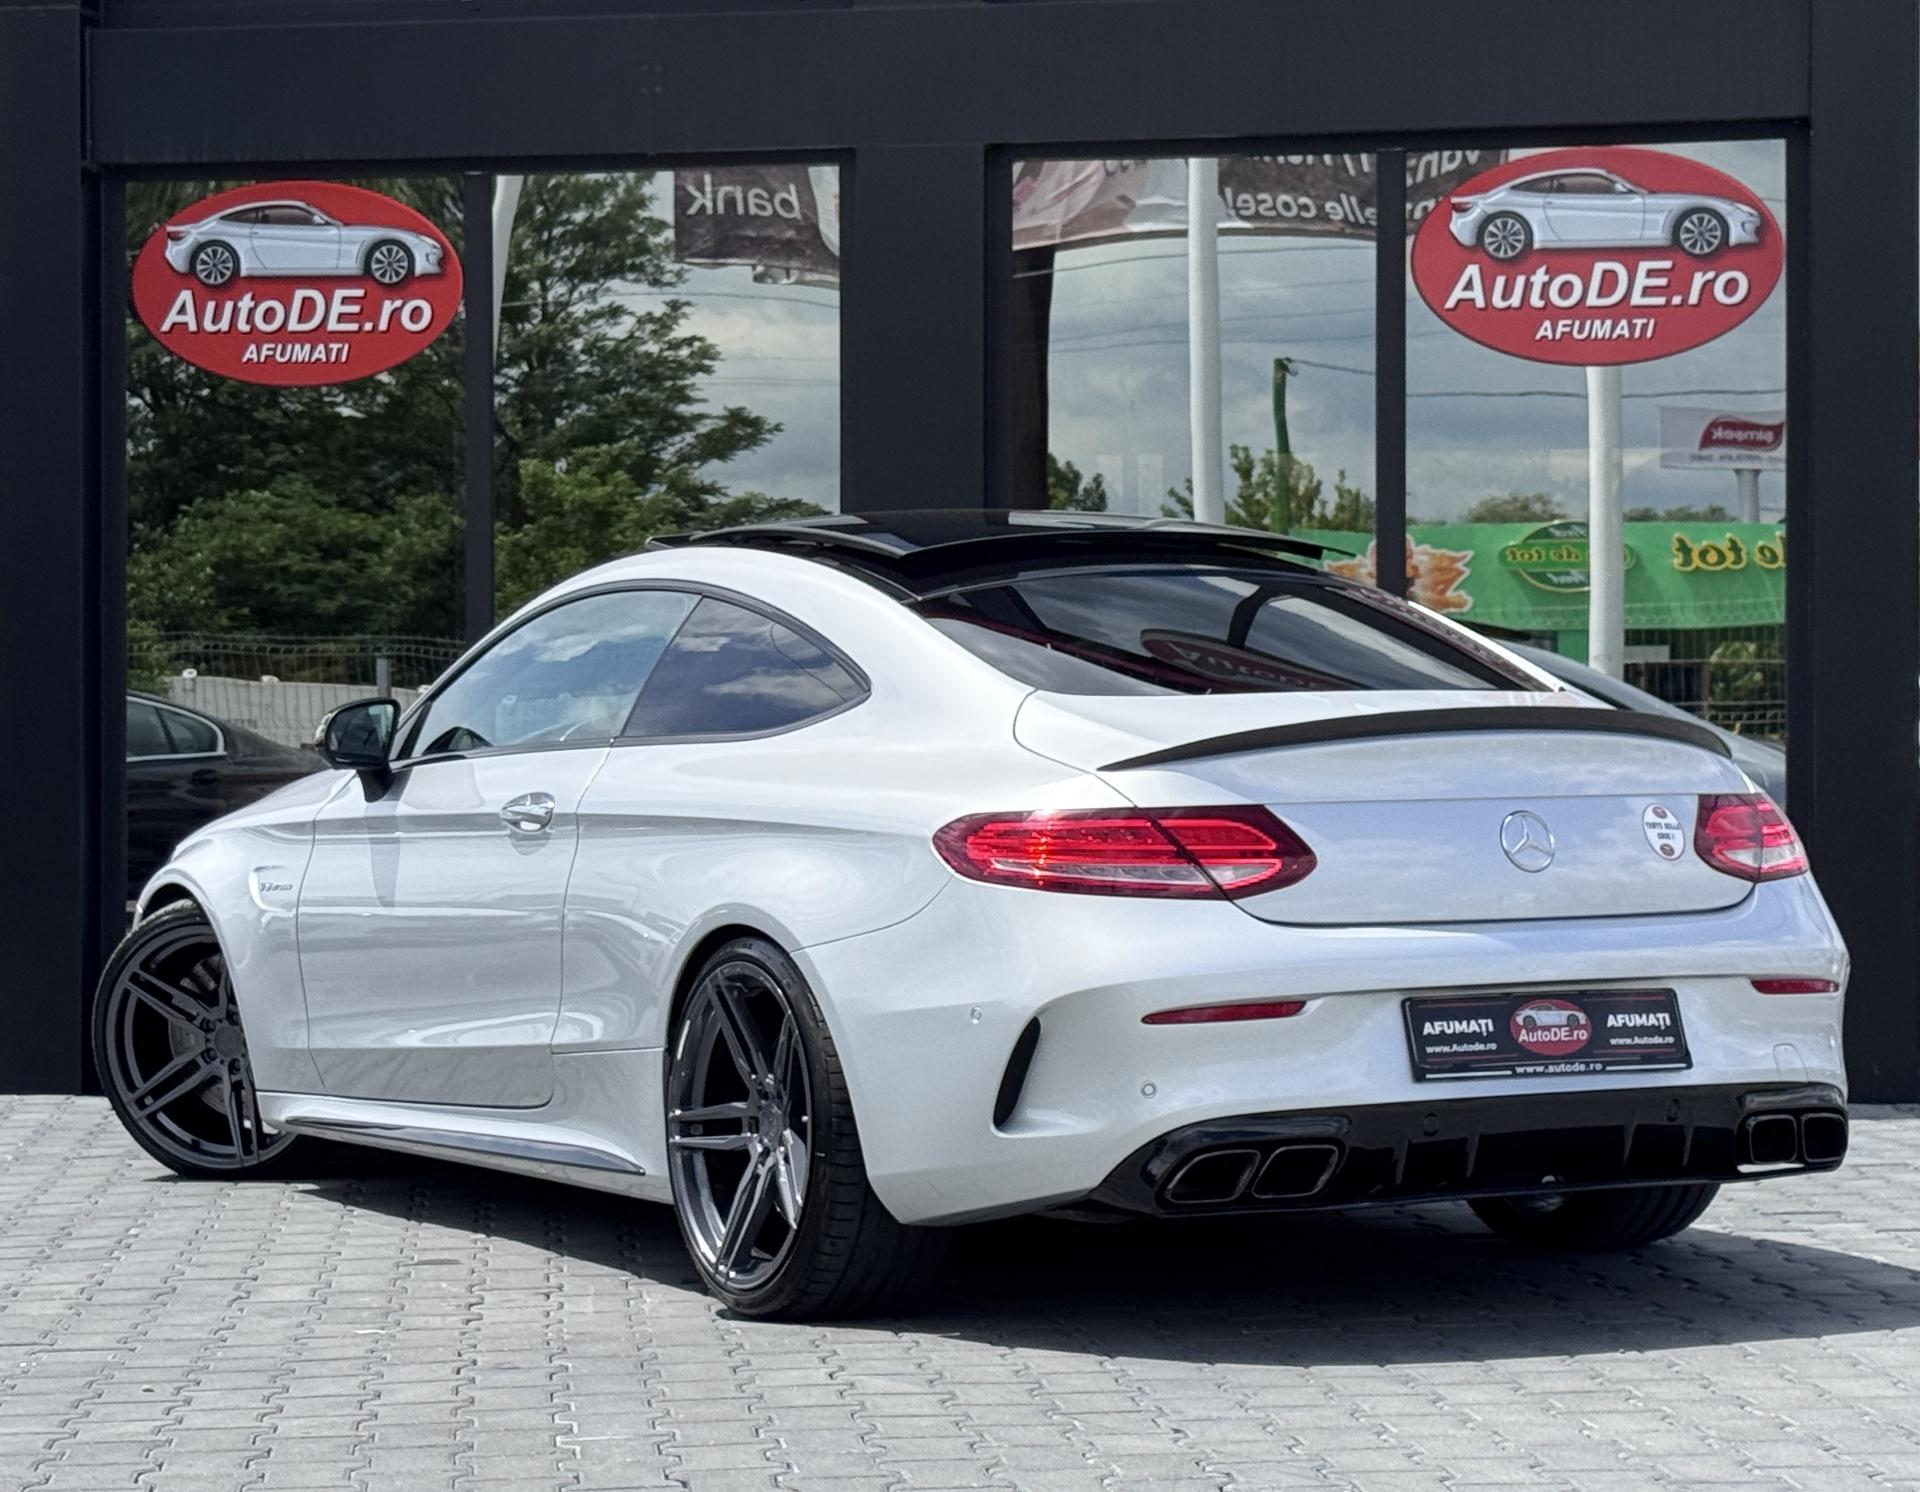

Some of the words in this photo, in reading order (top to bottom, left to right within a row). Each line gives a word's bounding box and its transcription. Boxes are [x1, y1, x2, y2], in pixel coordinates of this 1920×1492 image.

[1444, 260, 1750, 309] AutoDE.ro
[160, 289, 433, 334] AutoDE.ro
[1535, 318, 1656, 341] AFUMATI
[242, 343, 350, 364] AFUMATI
[1518, 1027, 1588, 1043] AutoDE.ro
[1515, 1062, 1603, 1074] www.autode.ro
